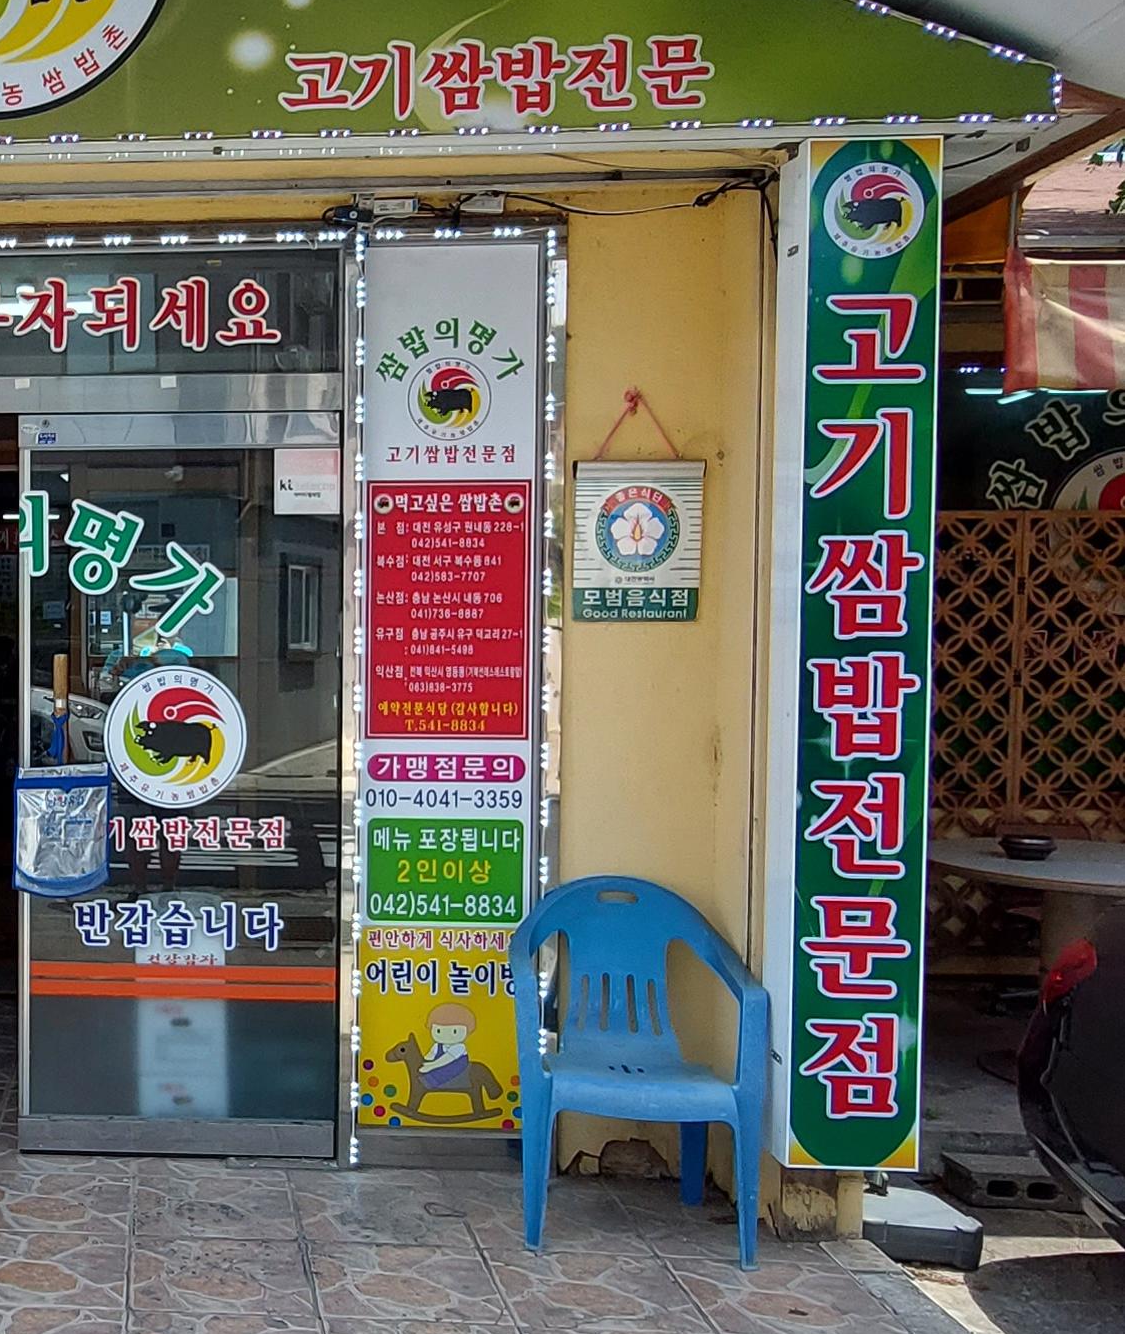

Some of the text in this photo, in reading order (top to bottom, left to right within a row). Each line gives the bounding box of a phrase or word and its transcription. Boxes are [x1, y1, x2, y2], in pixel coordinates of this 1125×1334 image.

[278, 34, 715, 120] 고기쌈밥전문
[375, 317, 525, 383] 쌈밥의명가
[386, 443, 517, 465] 고기쌈밥전문점
[394, 491, 504, 514] 먹고싶은 쌈밥촌
[412, 521, 432, 535] 대전
[582, 588, 690, 608] 모범음식점
[582, 608, 687, 619] Good Restaurant
[141, 674, 215, 695] 쌈밥의명가
[377, 701, 447, 717] 예약전문식당
[799, 293, 927, 1120] 고기쌈밥전문점
[377, 756, 515, 781] 가맹점문의
[365, 789, 524, 809] 010-4041-3359
[109, 816, 286, 852] 기쌈밥전문점
[373, 827, 521, 854] 메뉴 포장됩니다
[370, 891, 517, 919] 042)541-8834
[73, 898, 285, 952] 반갑습니다
[368, 929, 433, 950] 편안하게
[365, 957, 438, 996] 어린이
